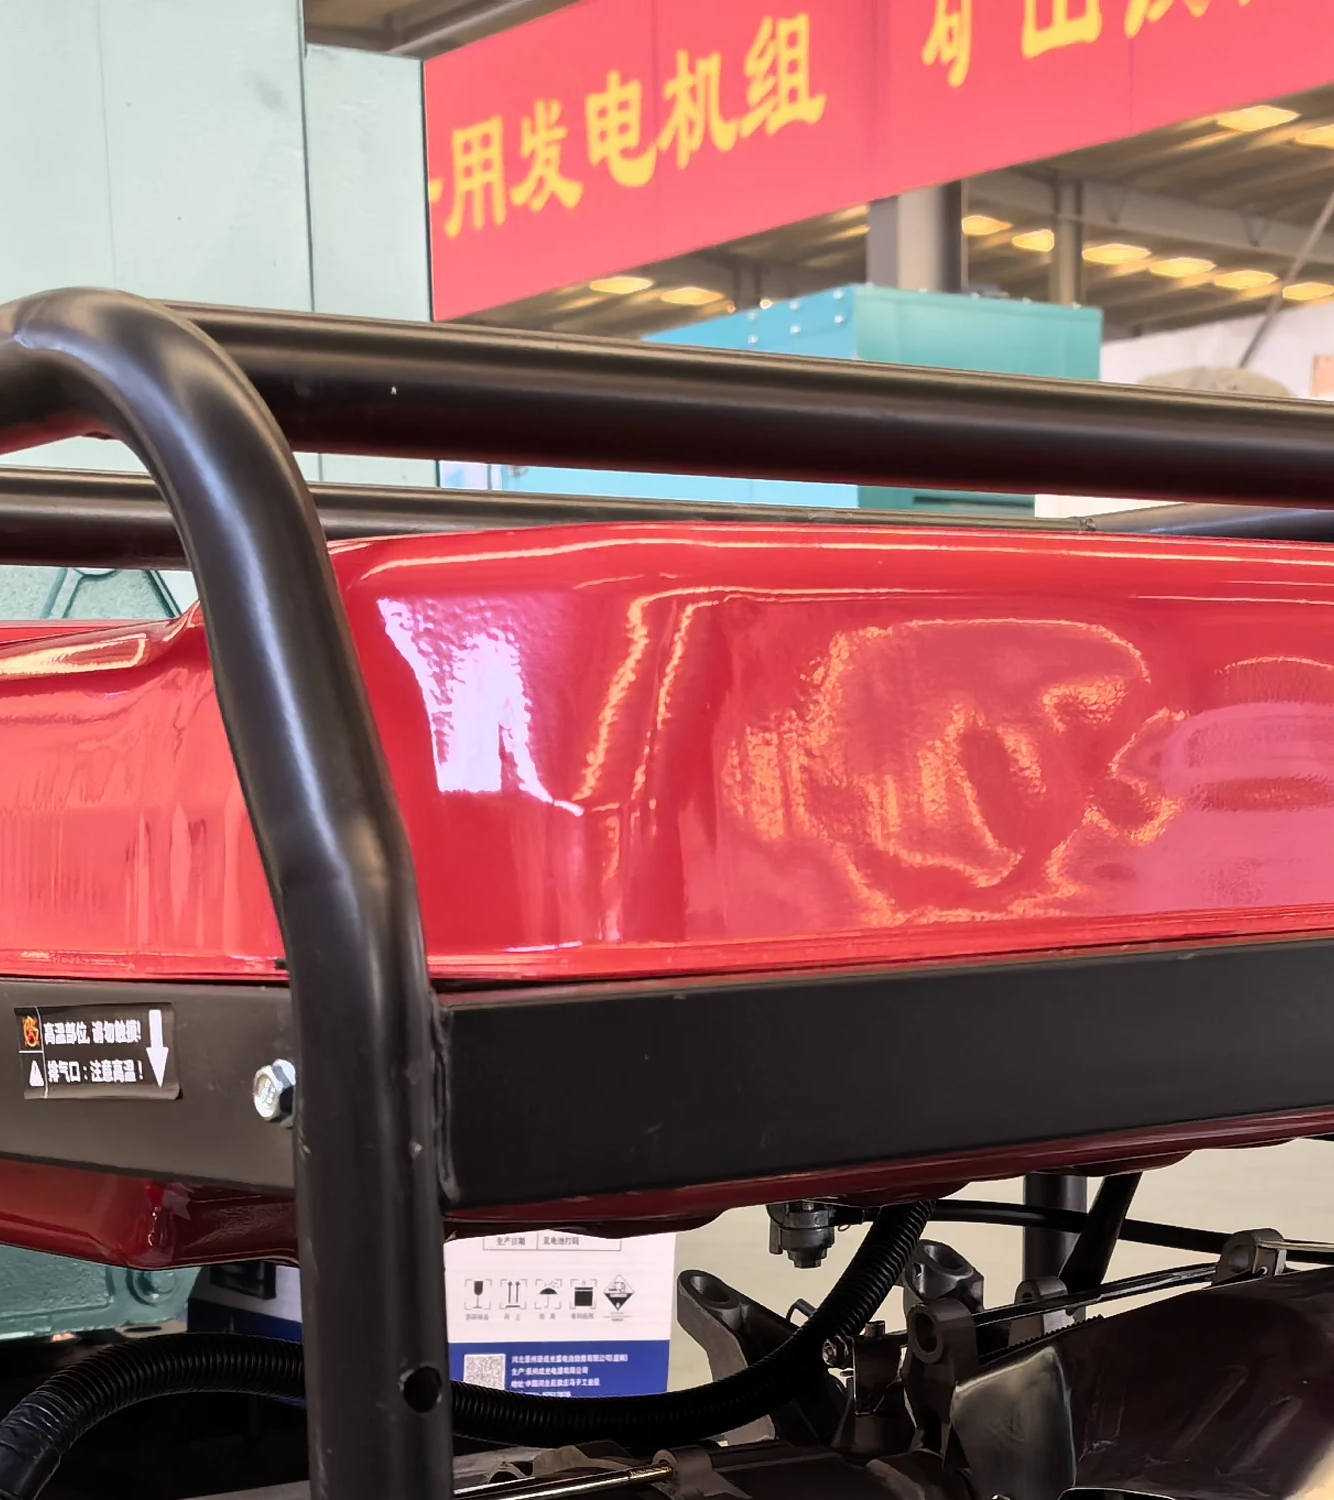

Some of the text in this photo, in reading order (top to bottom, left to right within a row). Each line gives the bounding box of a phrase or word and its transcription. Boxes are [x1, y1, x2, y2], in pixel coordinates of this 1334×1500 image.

[428, 13, 827, 239] 用发电机组
